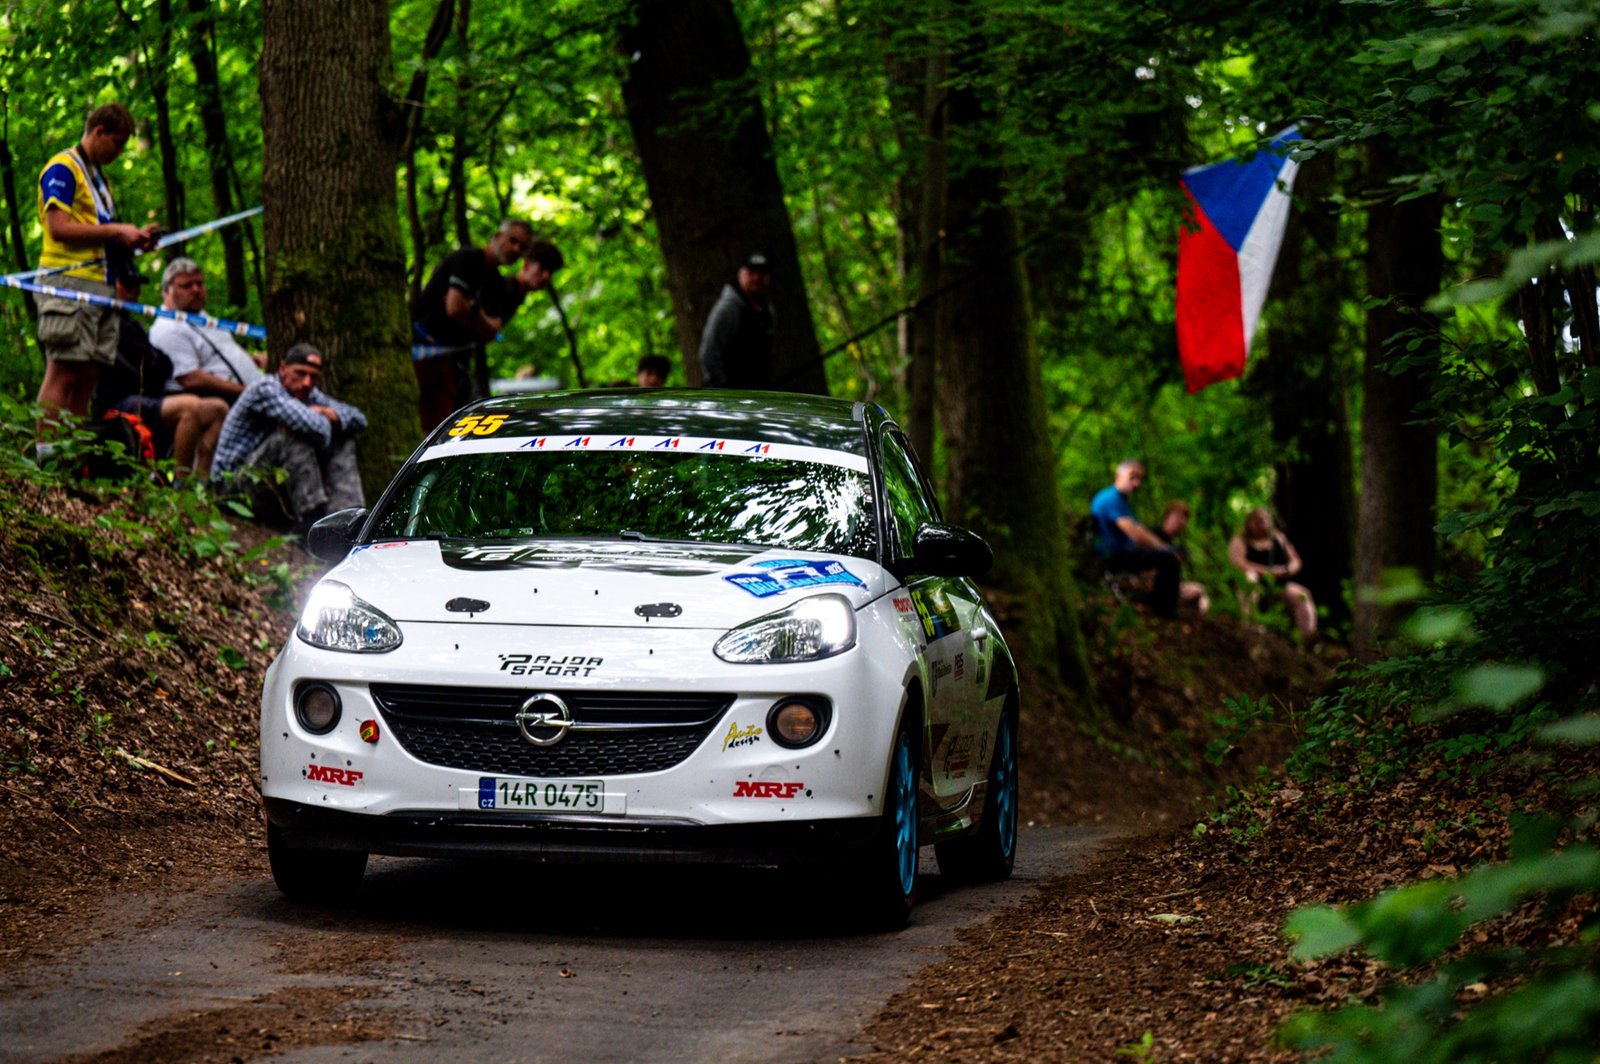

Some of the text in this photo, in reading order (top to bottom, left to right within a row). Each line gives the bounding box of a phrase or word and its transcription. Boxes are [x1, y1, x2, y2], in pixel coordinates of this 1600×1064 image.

[448, 414, 510, 437] 55
[511, 665, 596, 677] SPORT
[722, 722, 763, 752] Auto
[728, 735, 760, 748] design
[307, 764, 364, 786] MRF
[481, 782, 599, 808] CZ 14R 0475
[733, 781, 804, 799] MRF
